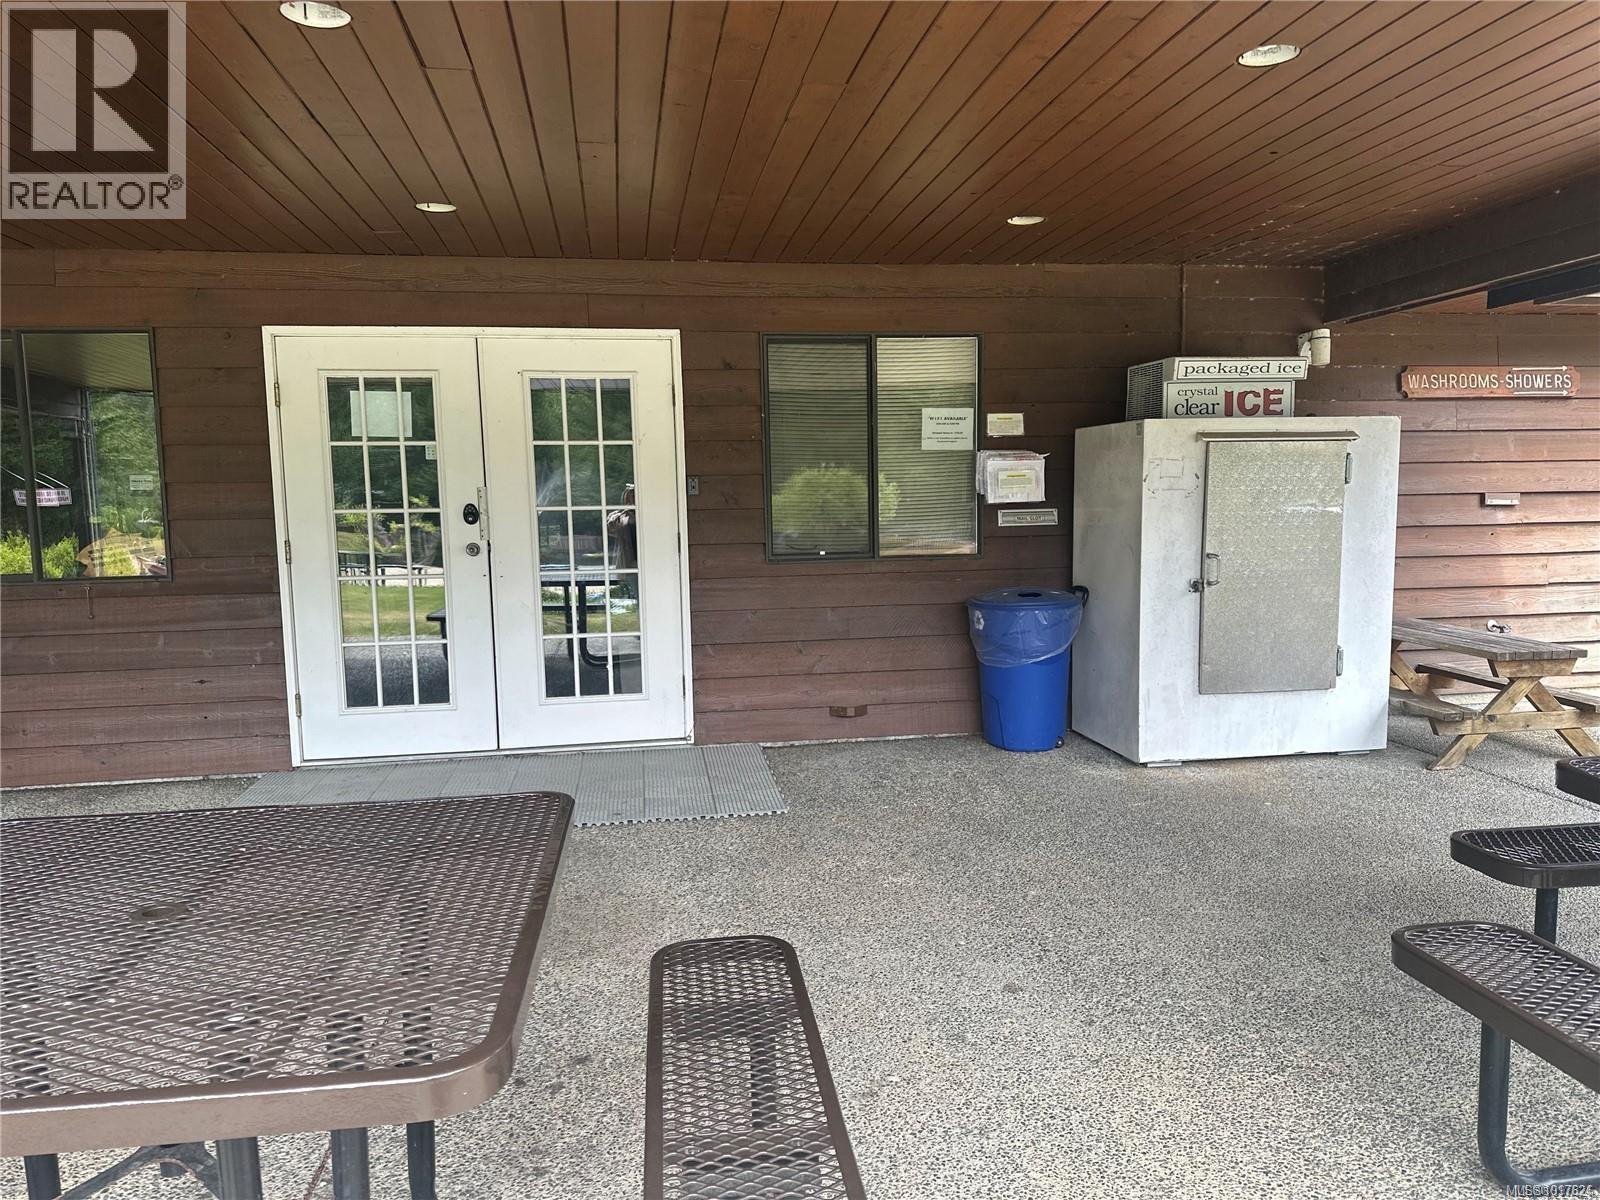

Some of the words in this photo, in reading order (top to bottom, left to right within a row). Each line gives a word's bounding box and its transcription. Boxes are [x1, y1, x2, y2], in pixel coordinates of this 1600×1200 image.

[1183, 363, 1270, 377] packaged
[1277, 363, 1302, 374] ice
[1177, 386, 1218, 398] crystal
[1174, 399, 1220, 416] clear
[1224, 387, 1284, 417] ICE
